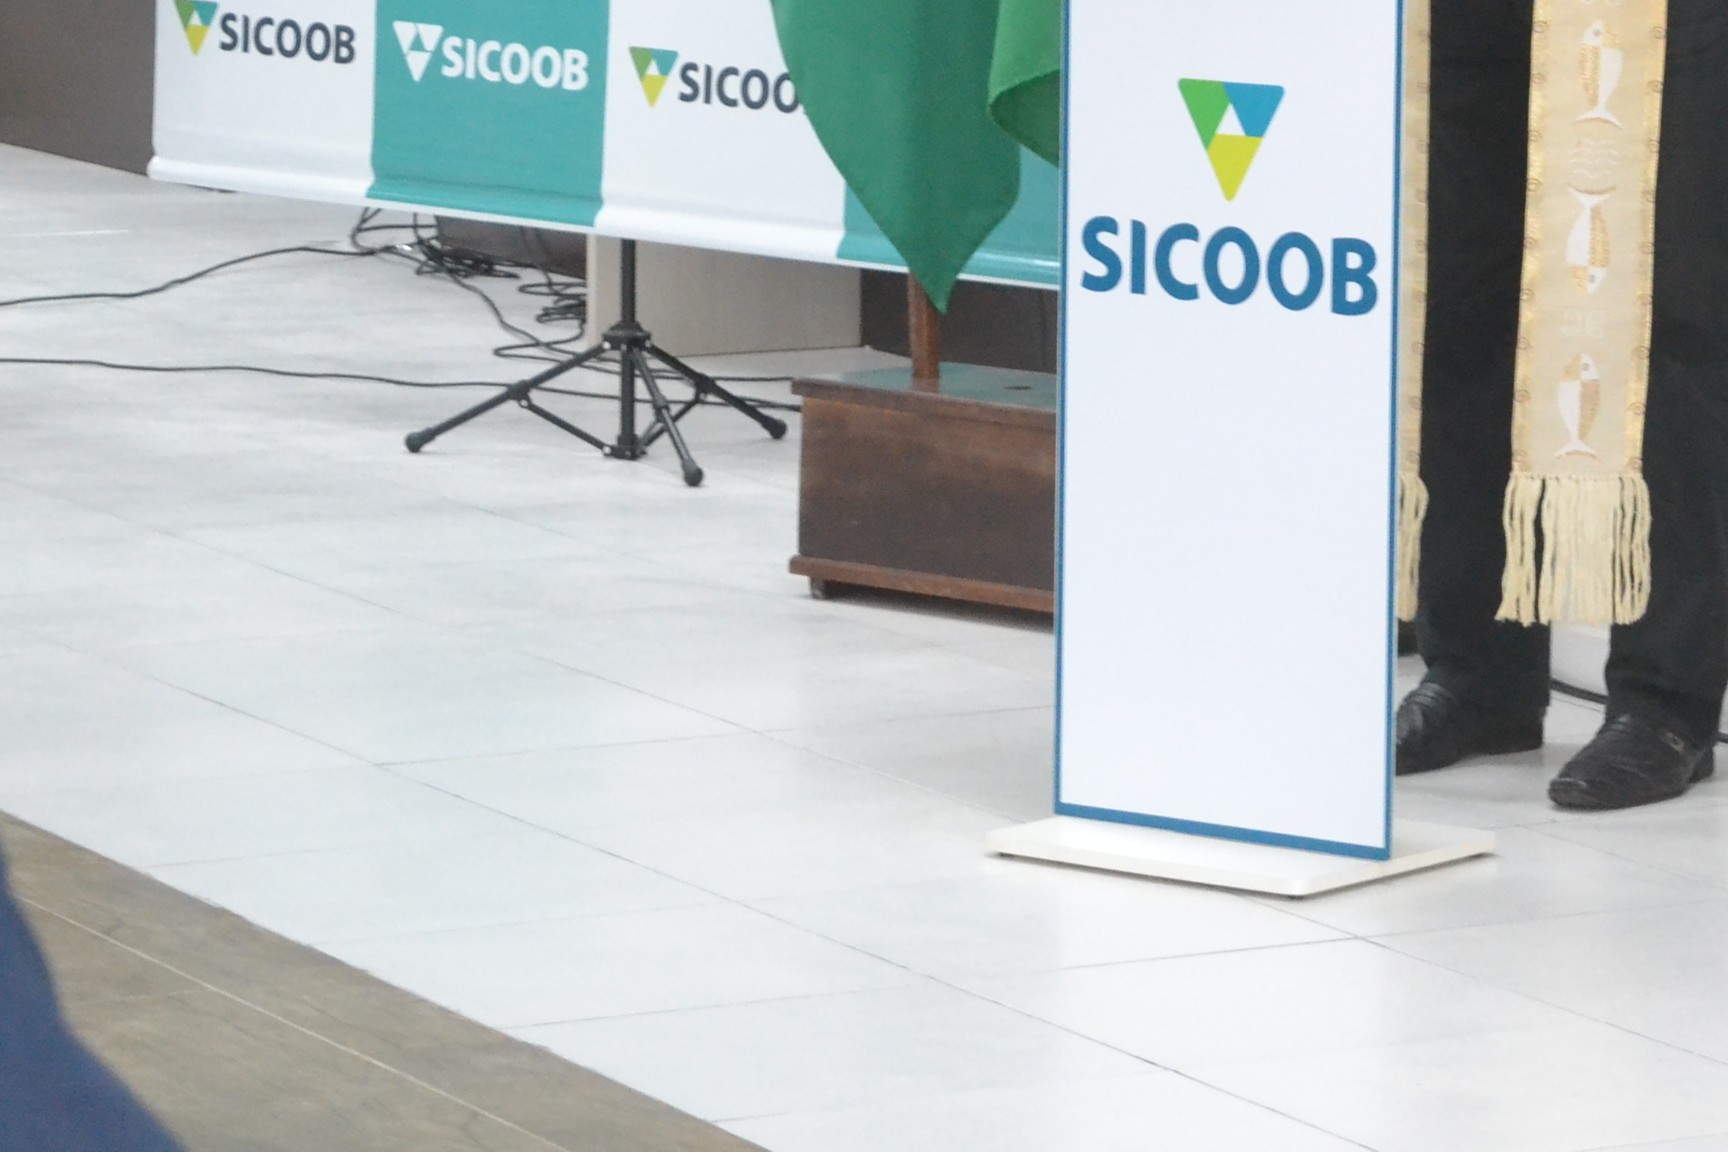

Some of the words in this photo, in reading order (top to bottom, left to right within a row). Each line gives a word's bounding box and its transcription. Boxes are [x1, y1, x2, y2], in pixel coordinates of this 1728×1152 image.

[219, 12, 356, 65] SICOOB
[441, 41, 589, 91] SICOOB
[679, 61, 801, 114] SICOO
[1080, 216, 1379, 317] SICOOB
